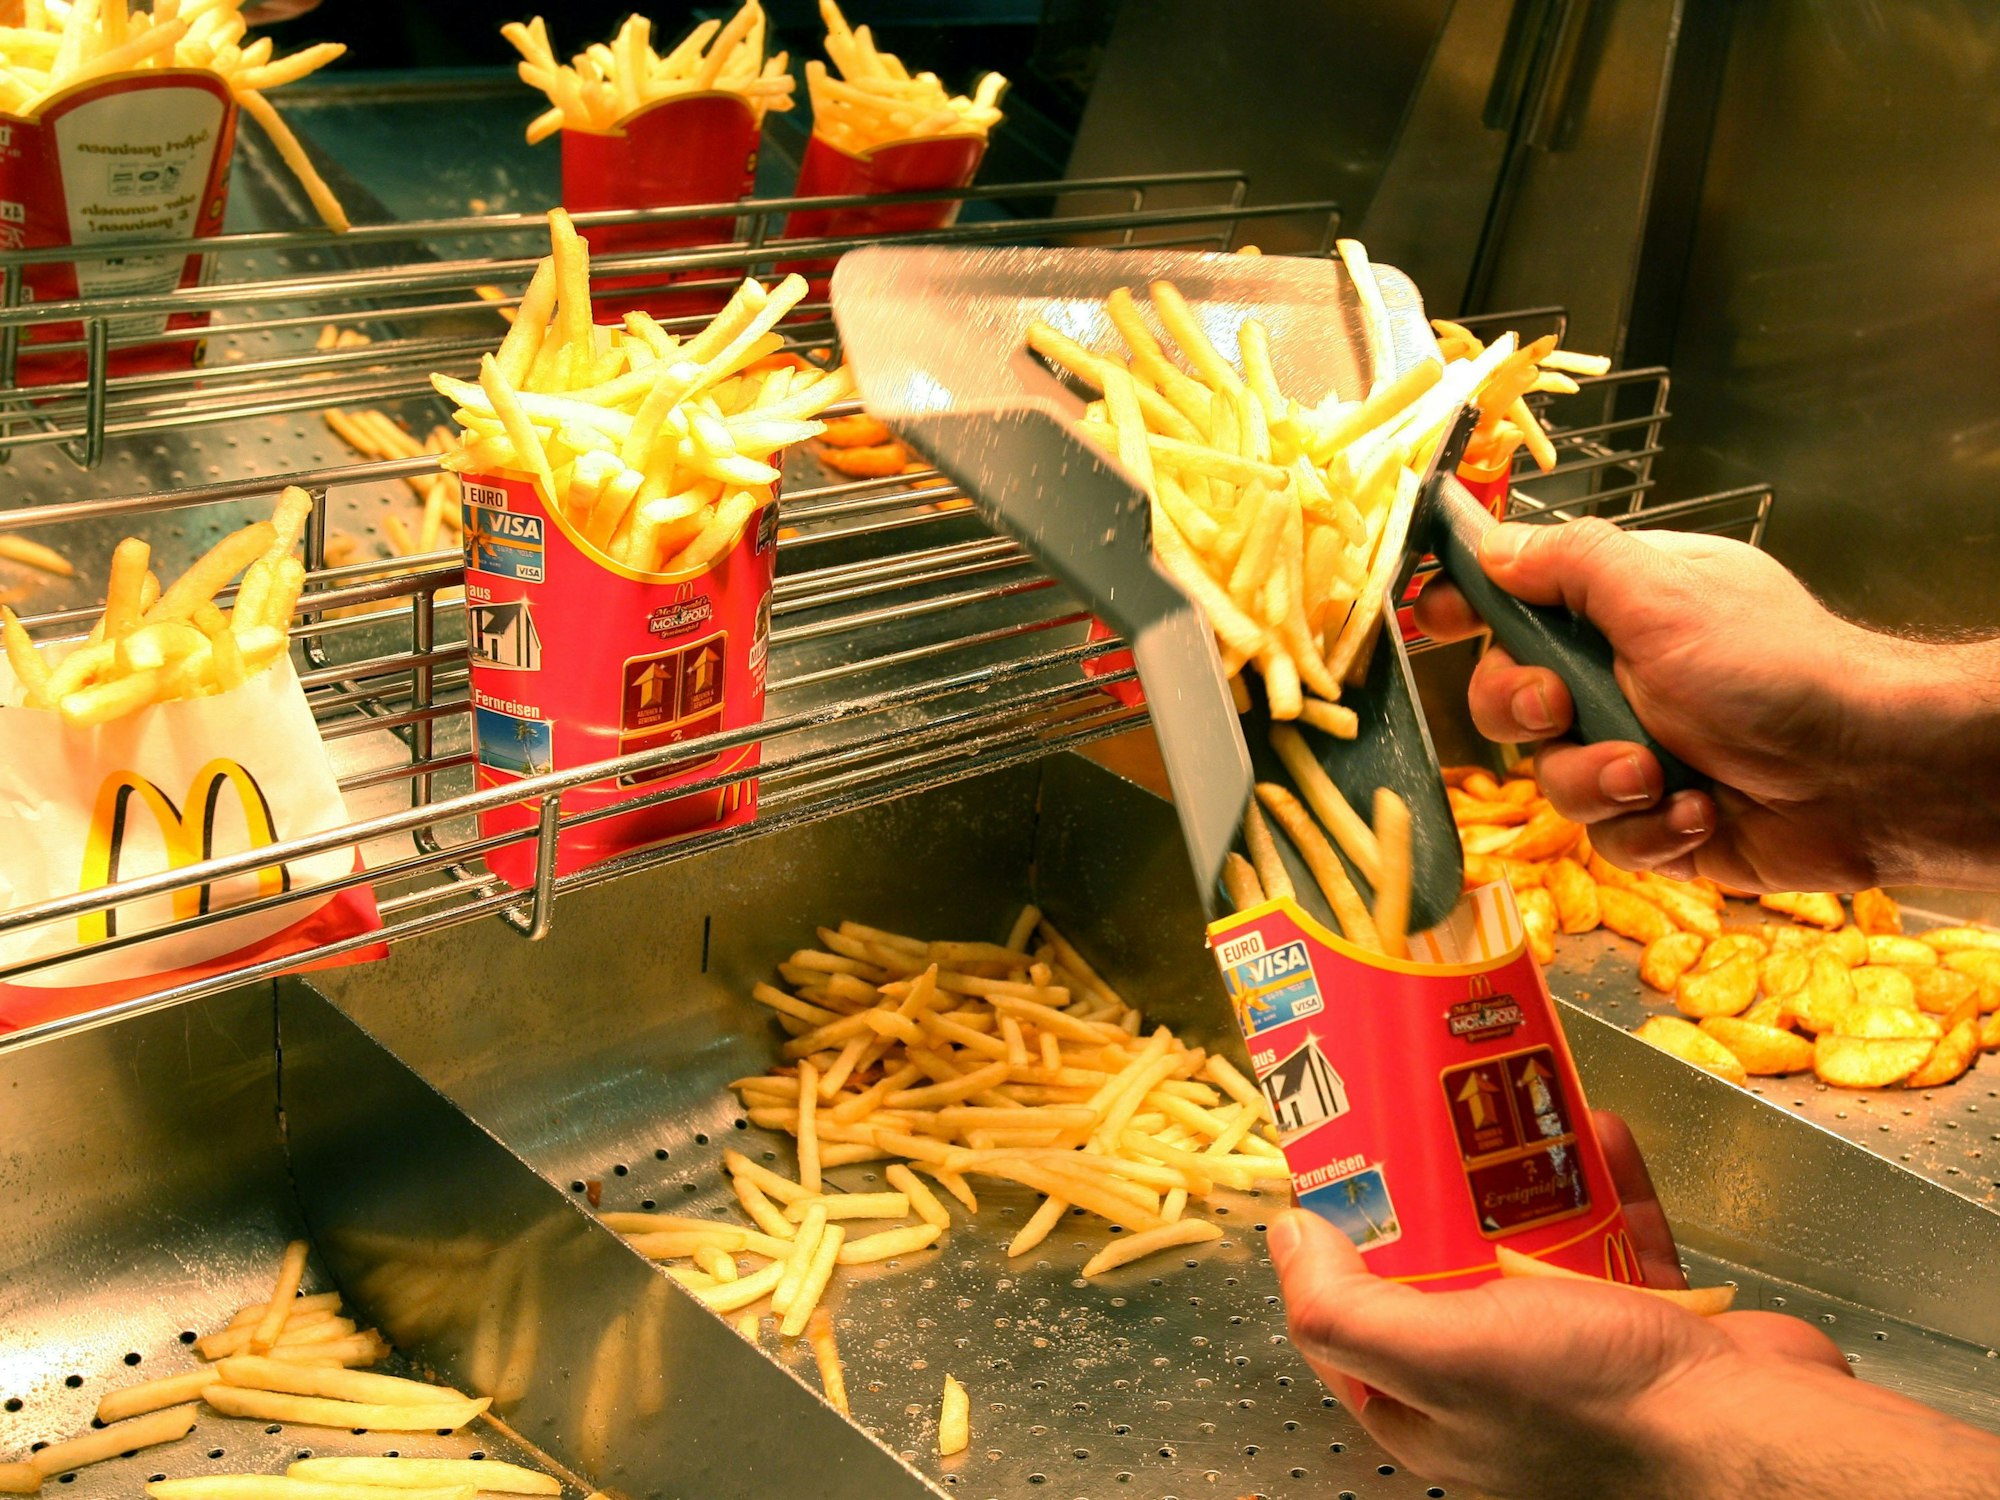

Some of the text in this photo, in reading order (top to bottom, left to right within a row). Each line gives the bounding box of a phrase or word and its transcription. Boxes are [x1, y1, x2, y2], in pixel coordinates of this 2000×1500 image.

[470, 487, 503, 507] EURO
[489, 512, 540, 539] VISA
[520, 567, 540, 577] VISA
[475, 688, 540, 718] Fernreisen
[1223, 937, 1260, 963] EURO
[1247, 945, 1306, 982] VISA
[1295, 998, 1318, 1012] VISA
[1291, 1153, 1366, 1191] Fernreisen
